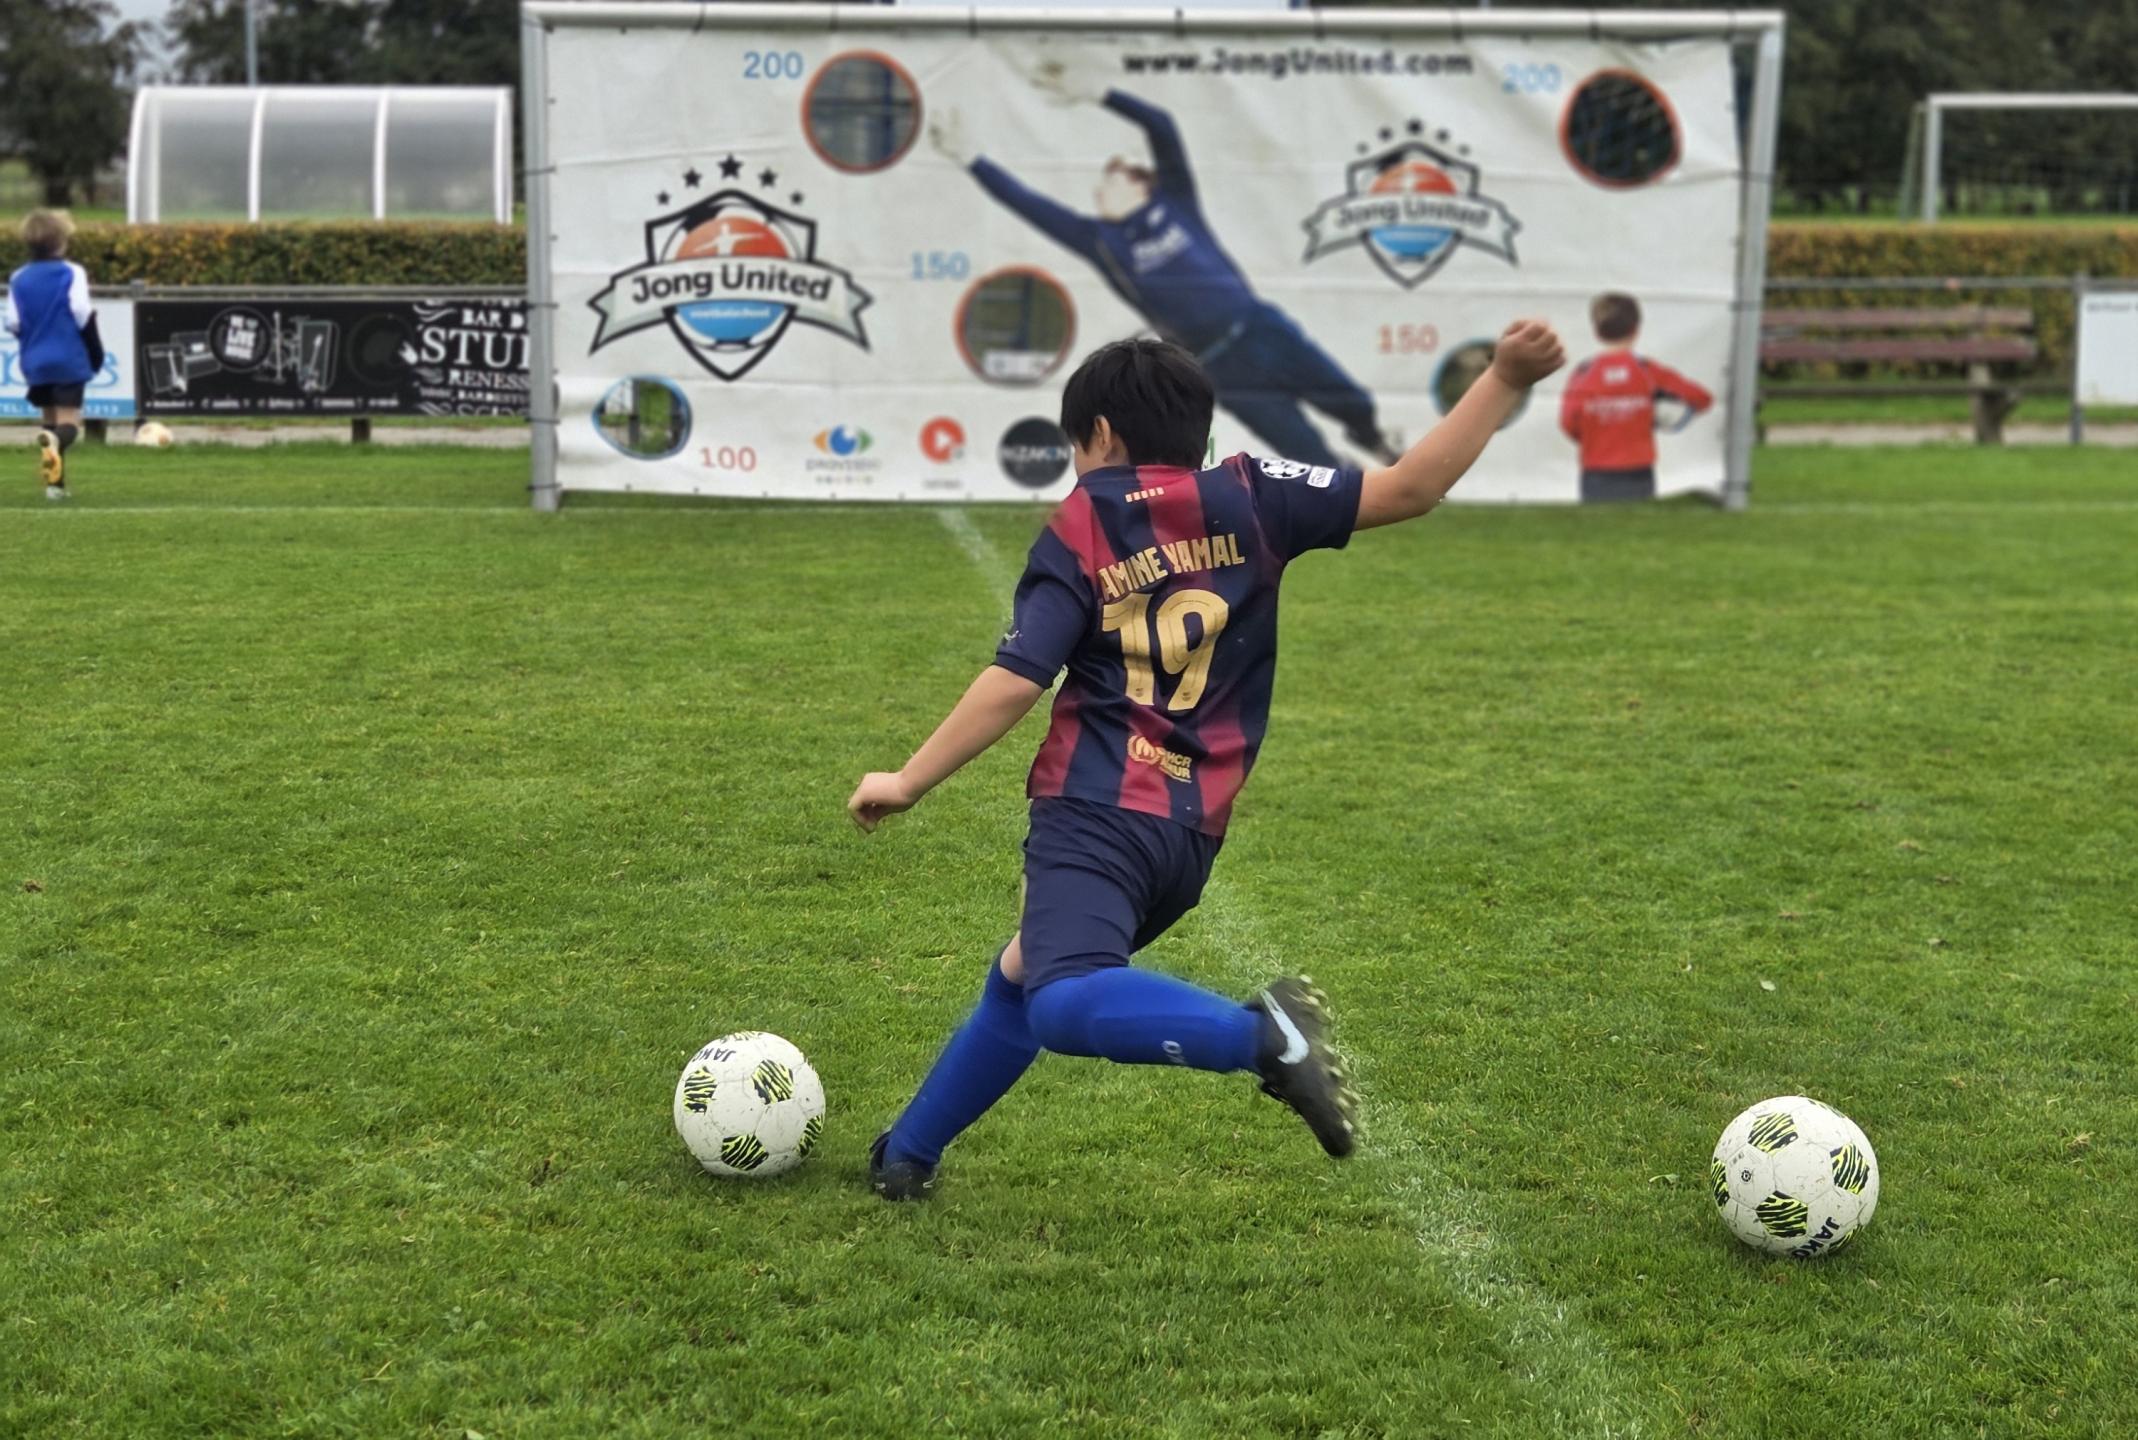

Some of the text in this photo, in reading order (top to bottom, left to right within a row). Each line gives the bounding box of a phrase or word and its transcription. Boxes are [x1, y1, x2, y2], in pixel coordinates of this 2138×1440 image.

[743, 51, 804, 79] 200
[1123, 48, 1474, 79] www.JongUnited.com
[1502, 63, 1562, 93] 200
[911, 251, 970, 280] 150
[632, 263, 832, 304] Jong United
[462, 308, 501, 327] BAR
[1378, 322, 1439, 354] 150
[699, 446, 757, 472] 100
[1161, 533, 1245, 574] YAMAL
[1102, 589, 1229, 711] 19
